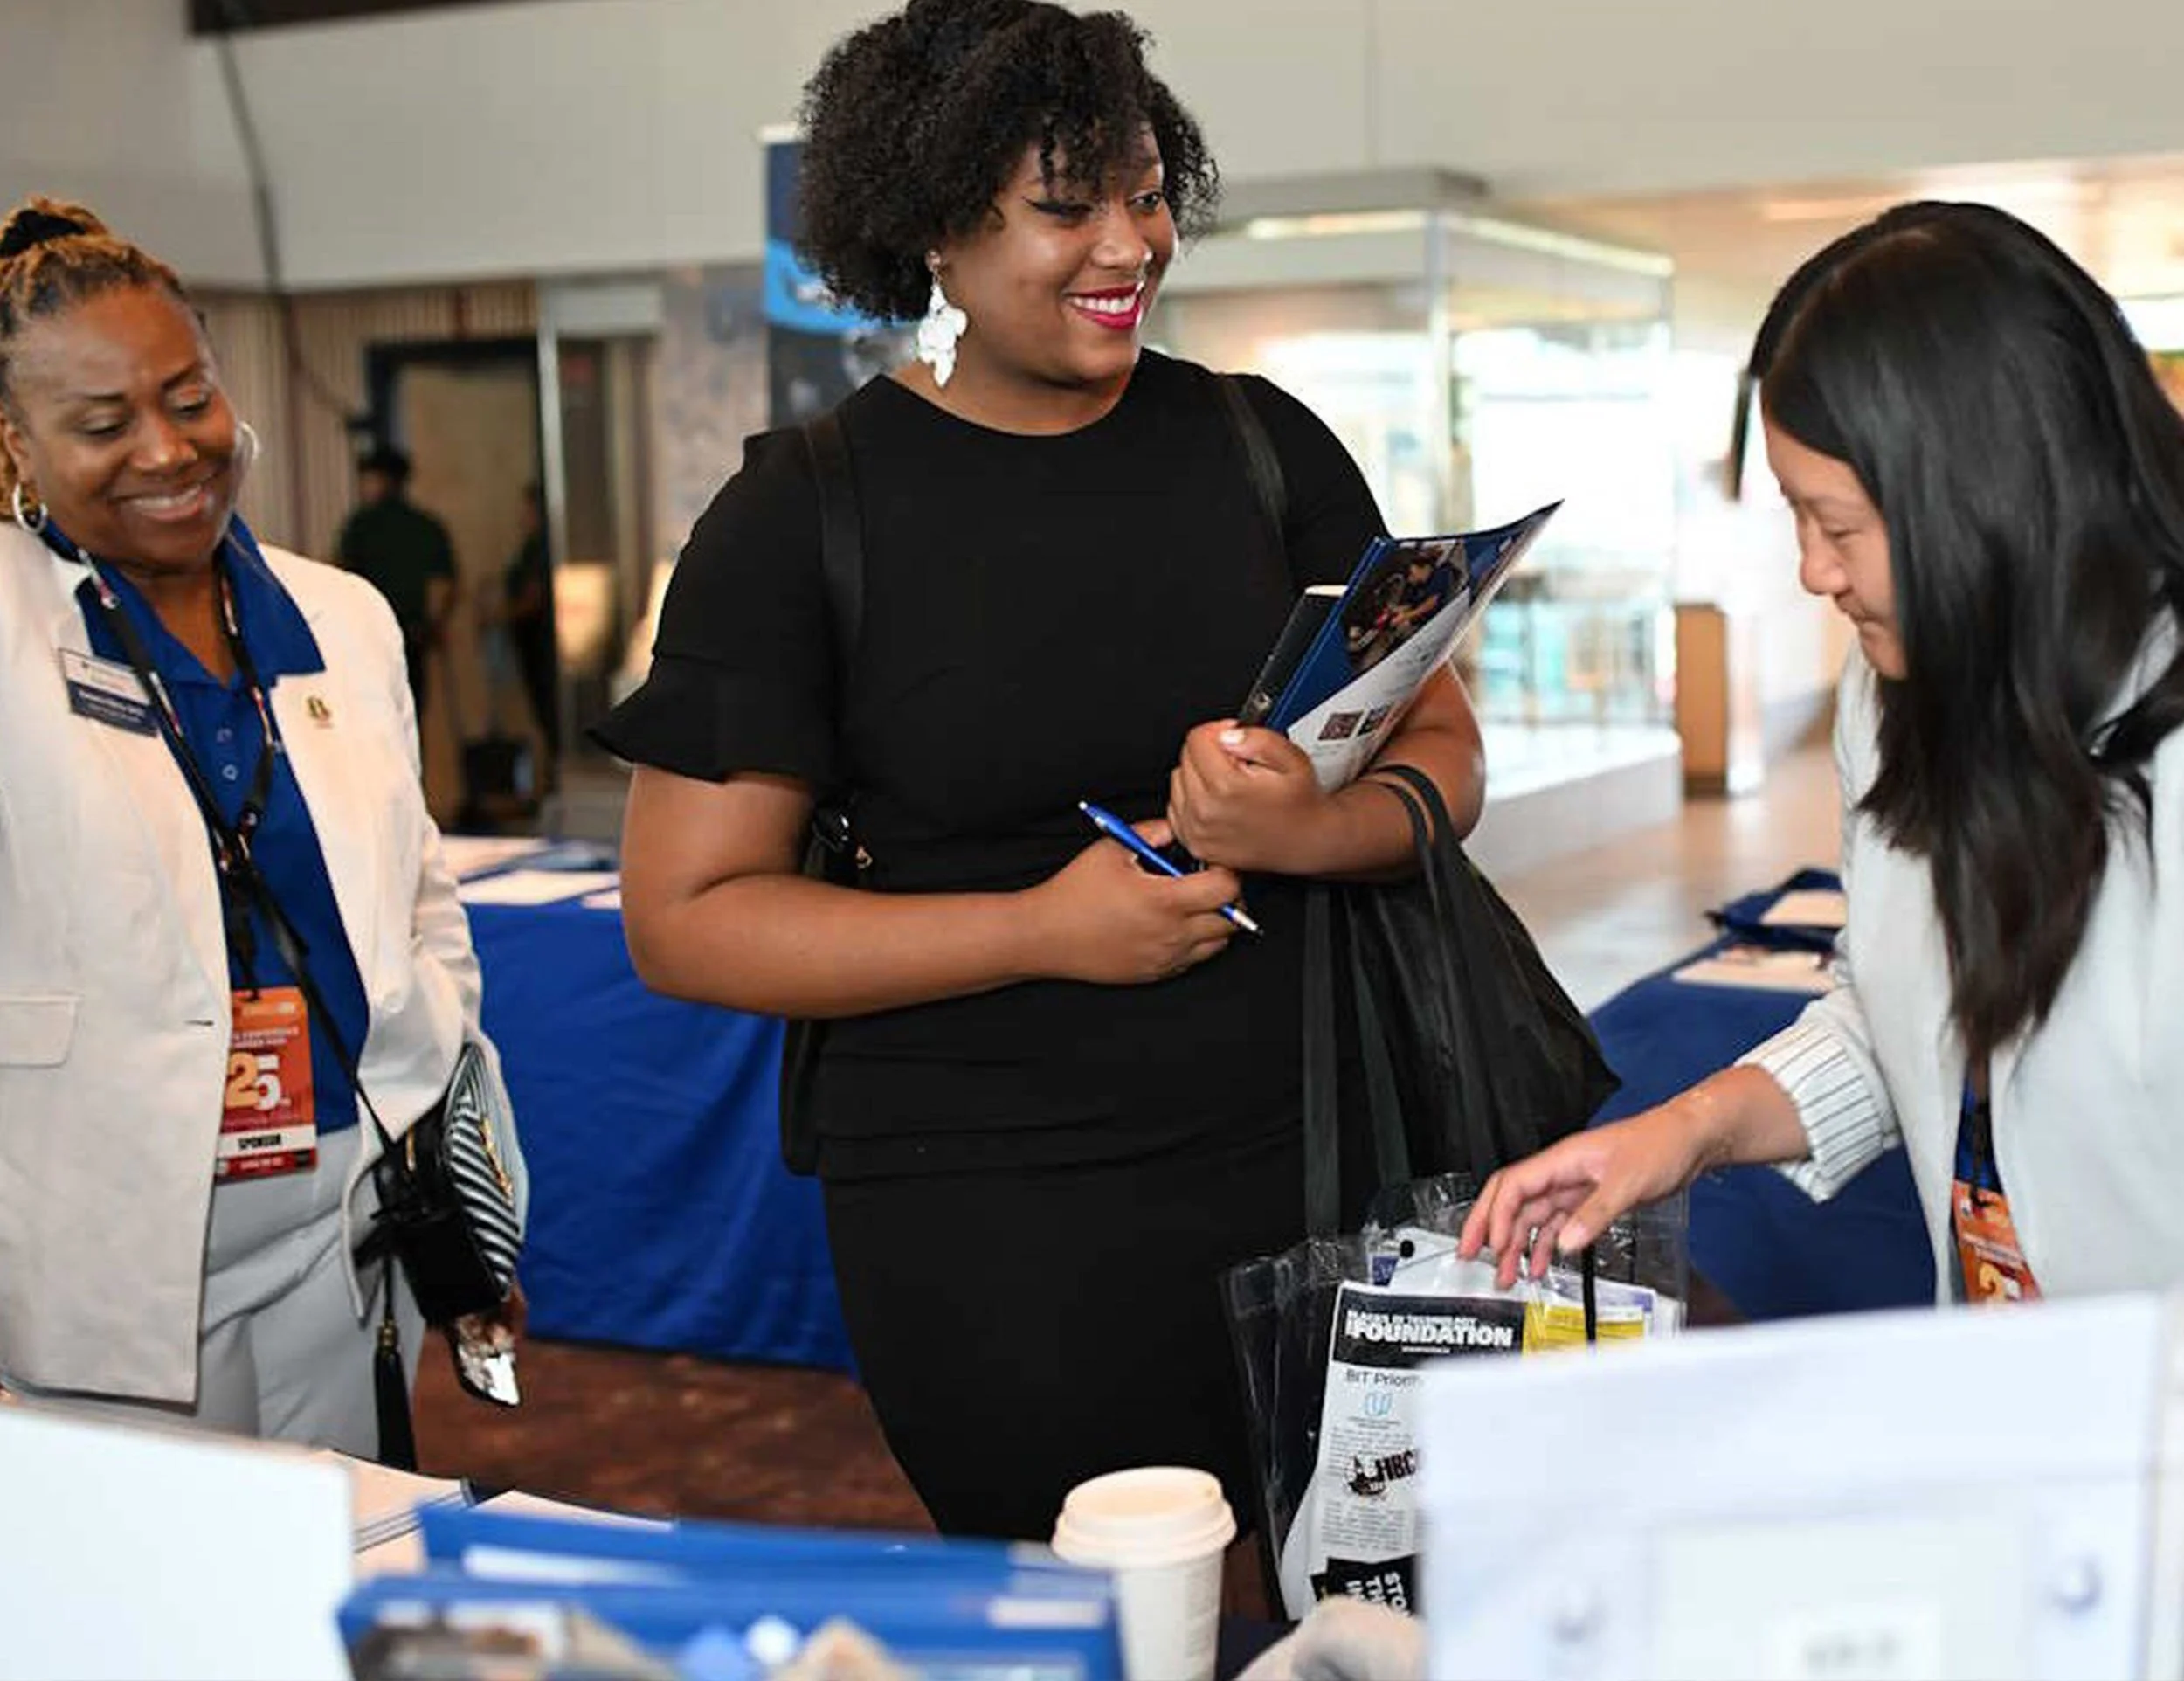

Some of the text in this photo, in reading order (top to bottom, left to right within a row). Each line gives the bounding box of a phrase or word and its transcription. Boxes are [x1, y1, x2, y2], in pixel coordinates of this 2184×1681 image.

[225, 1051, 281, 1110] 25
[1351, 1316, 1513, 1348] FOUNDATION
[1346, 1368, 1371, 1384] BIT
[1384, 1571, 1409, 1615] STO
